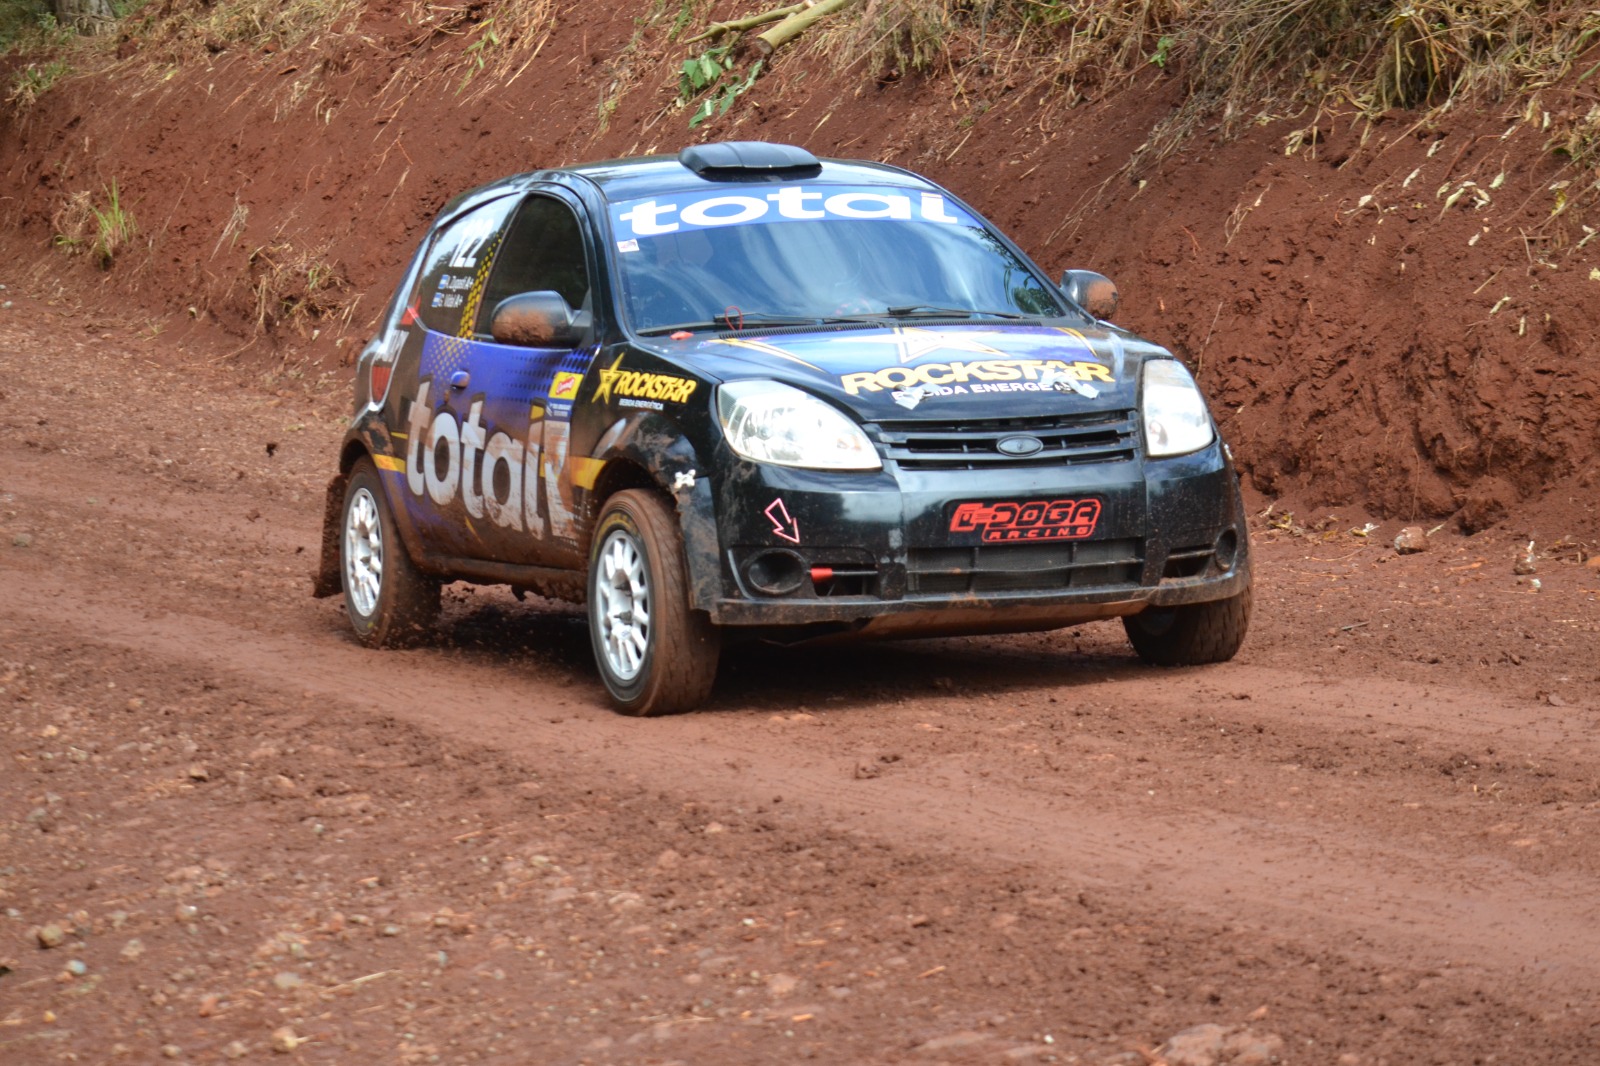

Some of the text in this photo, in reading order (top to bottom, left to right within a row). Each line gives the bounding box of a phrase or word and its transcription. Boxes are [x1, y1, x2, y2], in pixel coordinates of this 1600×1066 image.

[619, 186, 958, 235] total
[449, 217, 495, 268] 122
[613, 371, 697, 403] ROCKSTAR
[840, 359, 1116, 395] ROCKSTAR
[988, 526, 1090, 540] RACING
